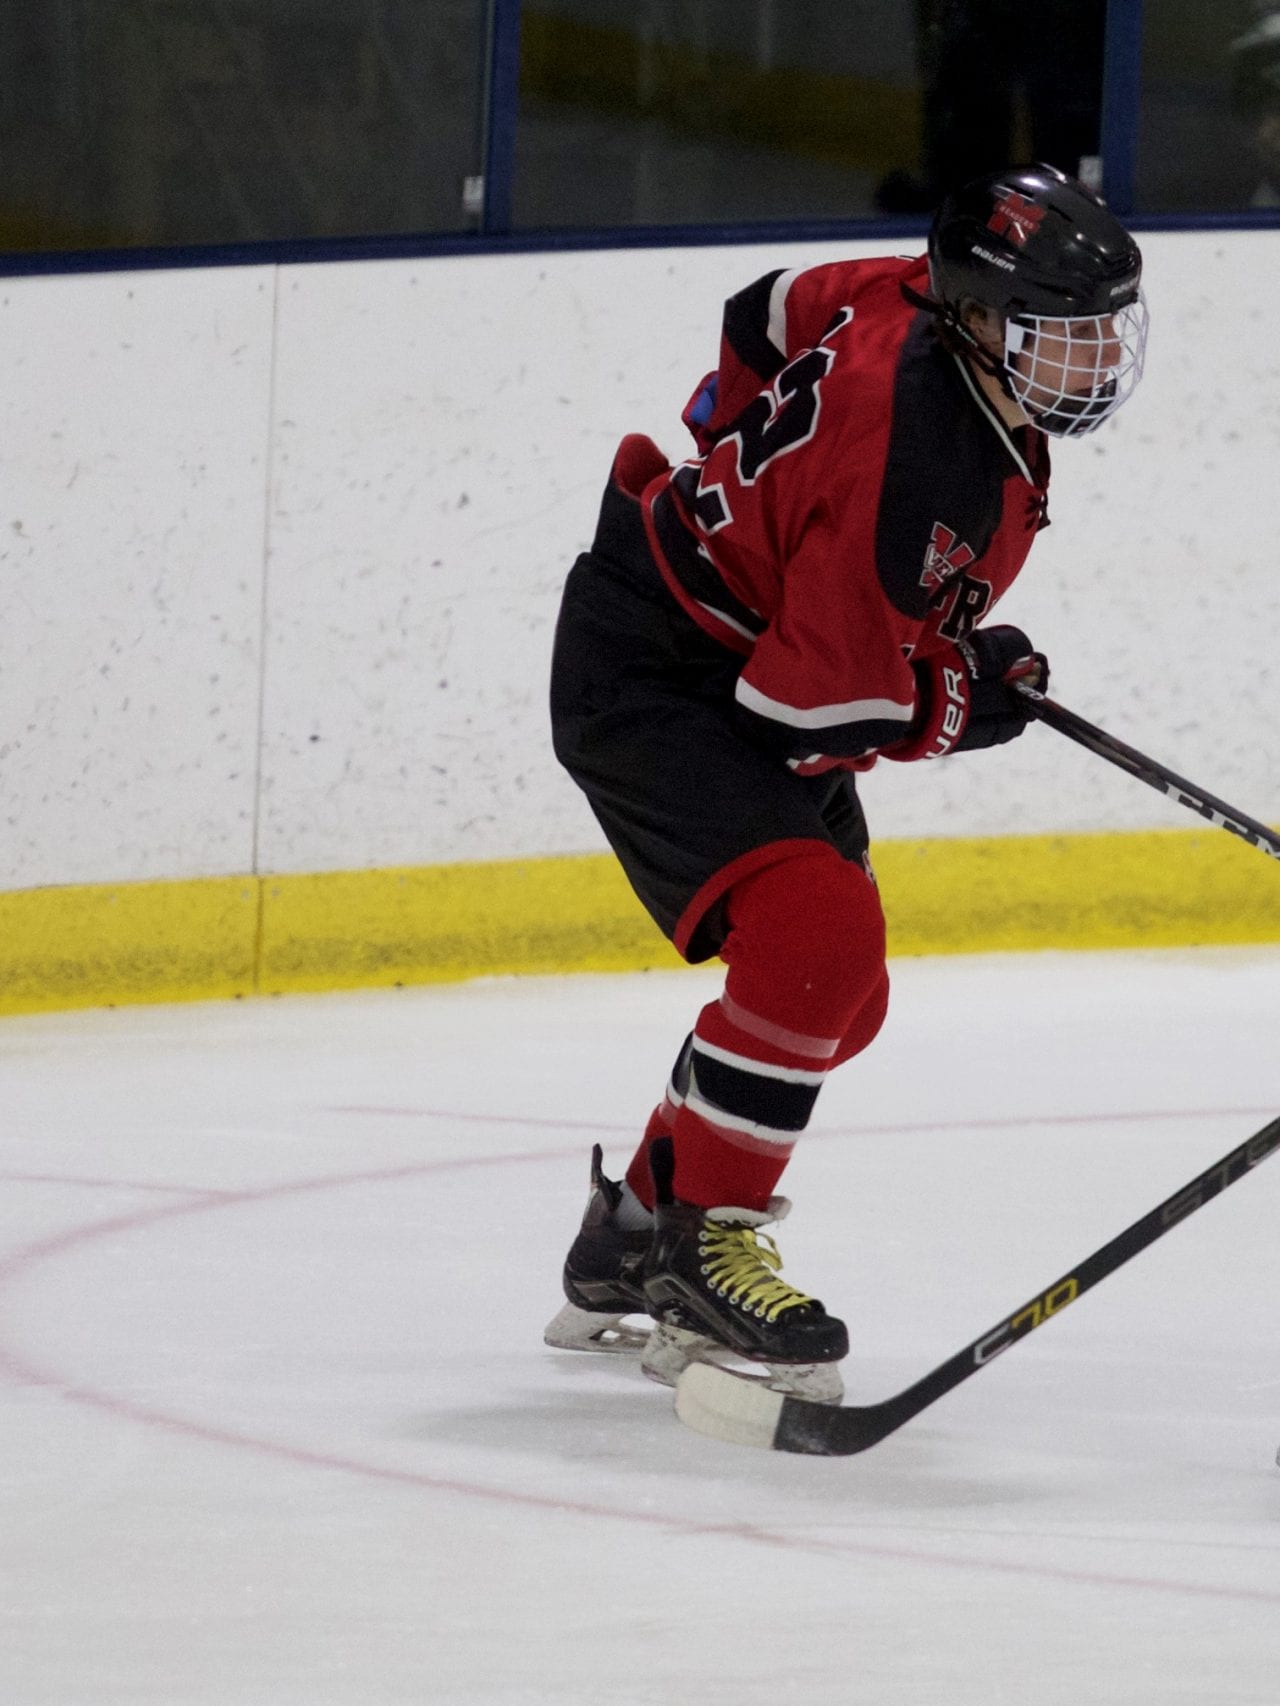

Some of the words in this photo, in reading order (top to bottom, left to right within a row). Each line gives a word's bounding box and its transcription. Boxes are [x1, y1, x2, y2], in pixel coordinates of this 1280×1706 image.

[971, 245, 1016, 272] BAUER
[924, 666, 966, 759] UER
[974, 1278, 1078, 1365] C70
